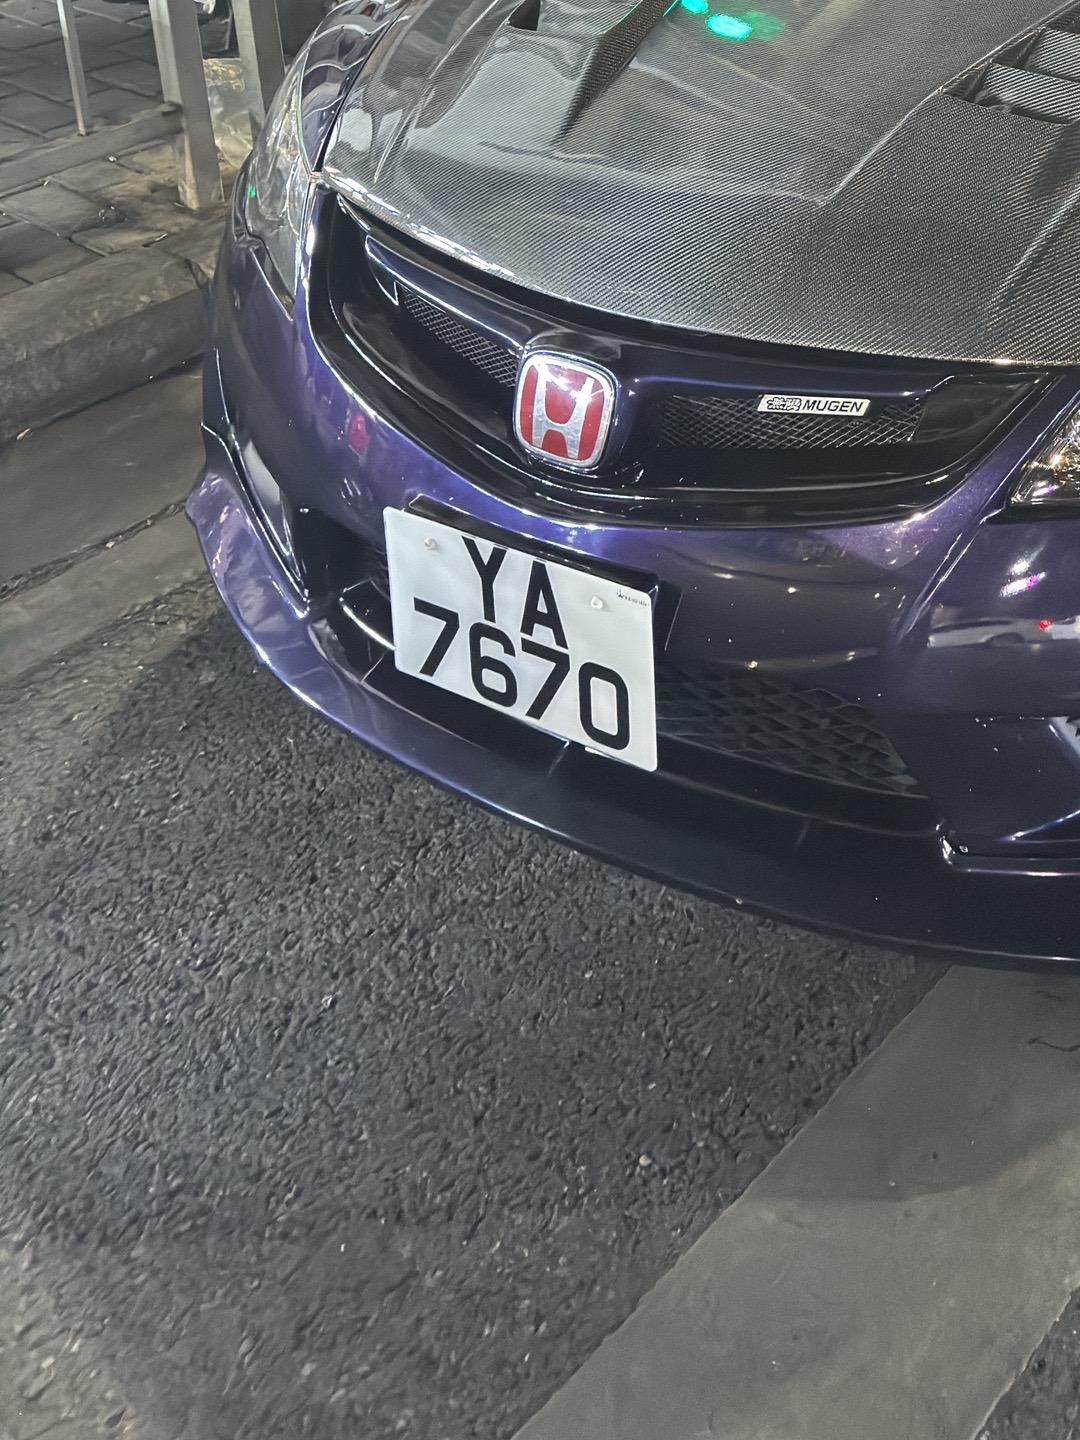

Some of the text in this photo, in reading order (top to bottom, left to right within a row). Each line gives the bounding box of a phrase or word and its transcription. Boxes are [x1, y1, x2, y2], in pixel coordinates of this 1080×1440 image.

[803, 399, 864, 413] MUGEN
[461, 536, 569, 650] YA
[414, 597, 630, 751] 7670
